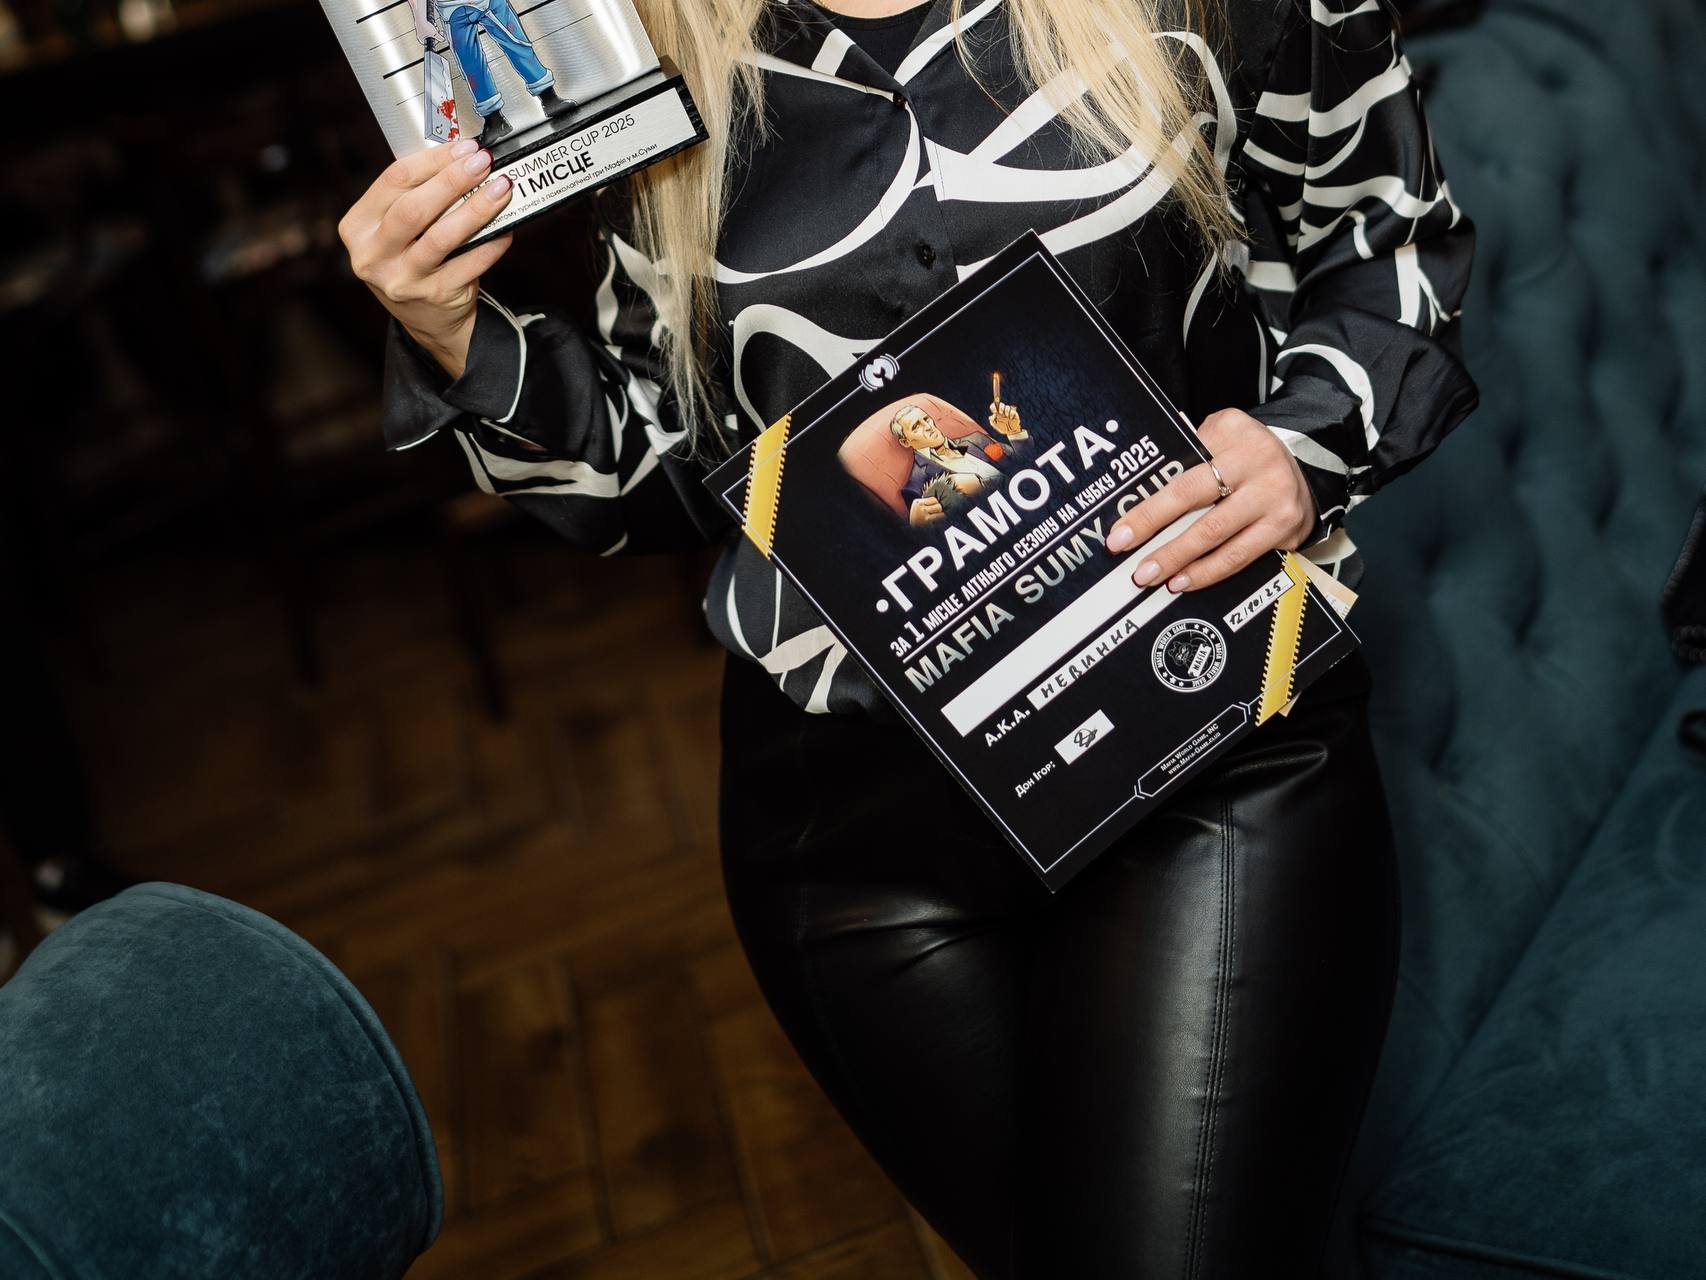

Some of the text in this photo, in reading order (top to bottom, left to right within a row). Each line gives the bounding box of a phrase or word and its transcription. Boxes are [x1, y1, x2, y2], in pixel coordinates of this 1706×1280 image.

[508, 114, 635, 182] SUMMER CUP 2025
[528, 151, 595, 196] МІСЦЕ
[604, 158, 627, 172] Мафія
[890, 435, 1160, 658] ЗА 1 МІСЦЕ ЛІТНЬОГО СЕЗОНУ НА КУБКУ 2025
[904, 602, 1015, 694] MAFIA
[1015, 516, 1106, 606] SUMY
